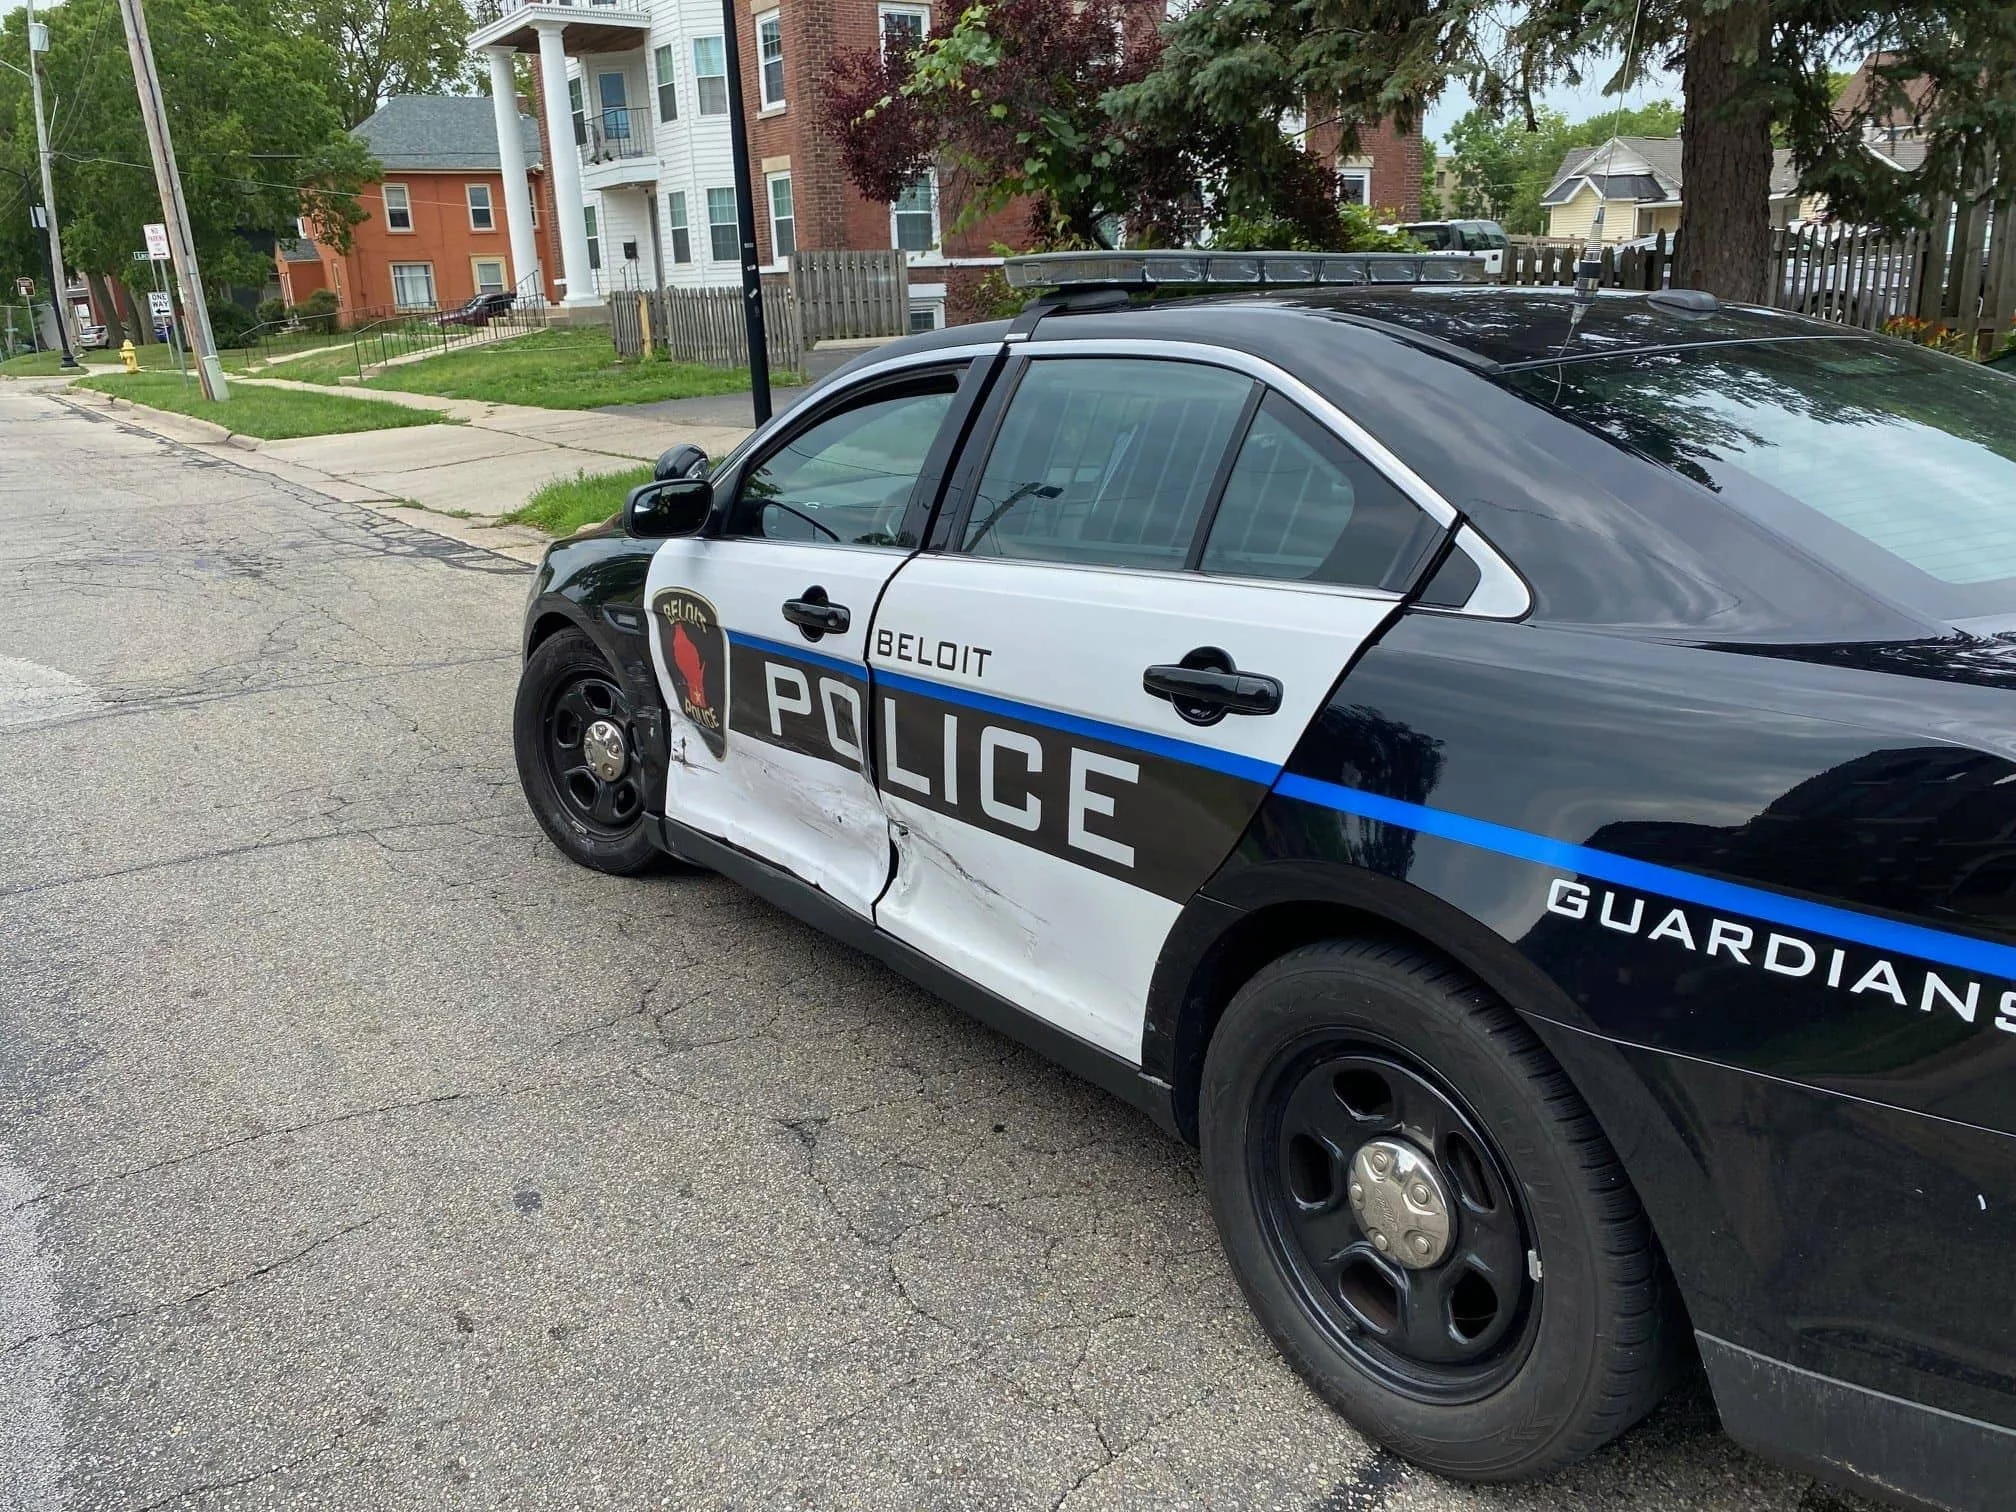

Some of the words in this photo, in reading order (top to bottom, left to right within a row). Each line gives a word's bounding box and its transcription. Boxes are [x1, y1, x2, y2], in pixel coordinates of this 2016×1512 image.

[151, 293, 167, 301] ONE
[152, 300, 169, 308] WAY
[663, 599, 708, 633] BELOIT
[877, 628, 993, 678] BELOIT
[684, 695, 720, 730] POLICE
[764, 660, 1140, 869] POLICE
